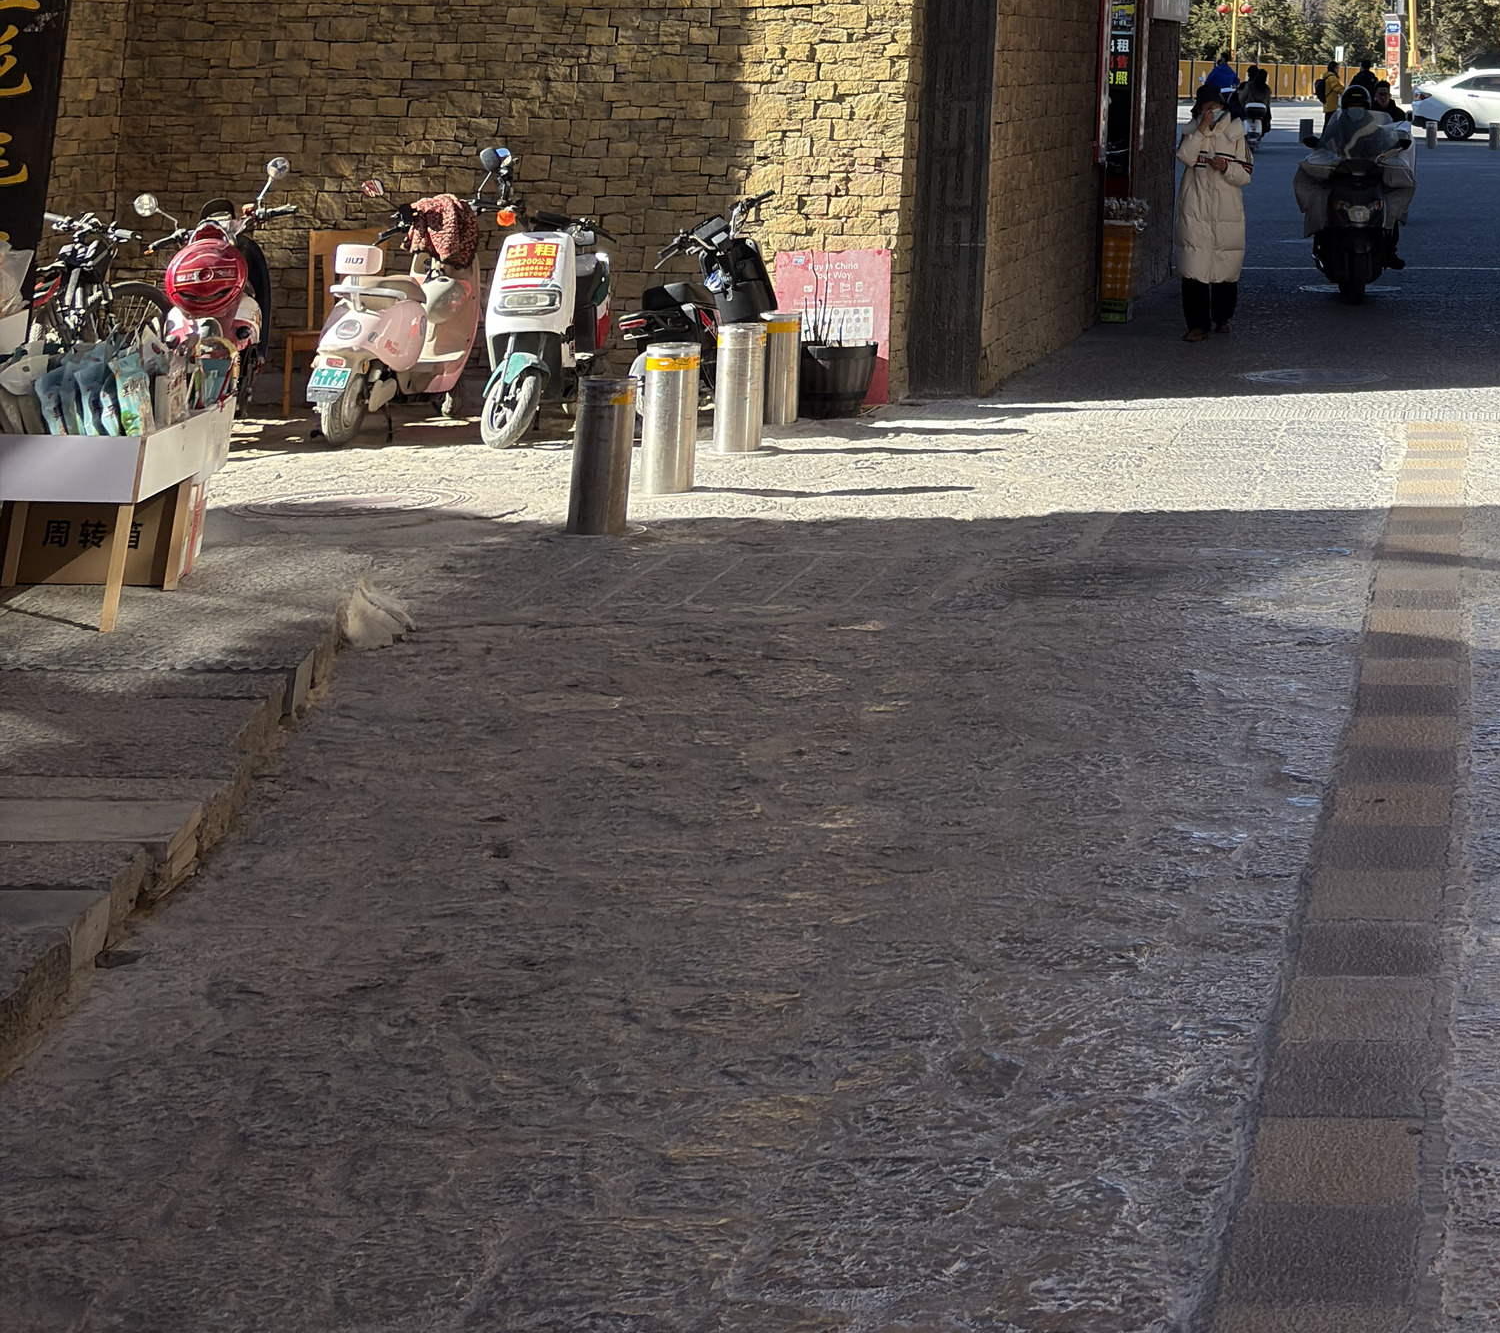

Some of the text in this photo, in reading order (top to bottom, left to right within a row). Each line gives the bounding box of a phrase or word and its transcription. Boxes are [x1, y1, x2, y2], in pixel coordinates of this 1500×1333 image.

[506, 243, 557, 260] 出租
[835, 261, 859, 270] China
[312, 376, 345, 387] 01166
